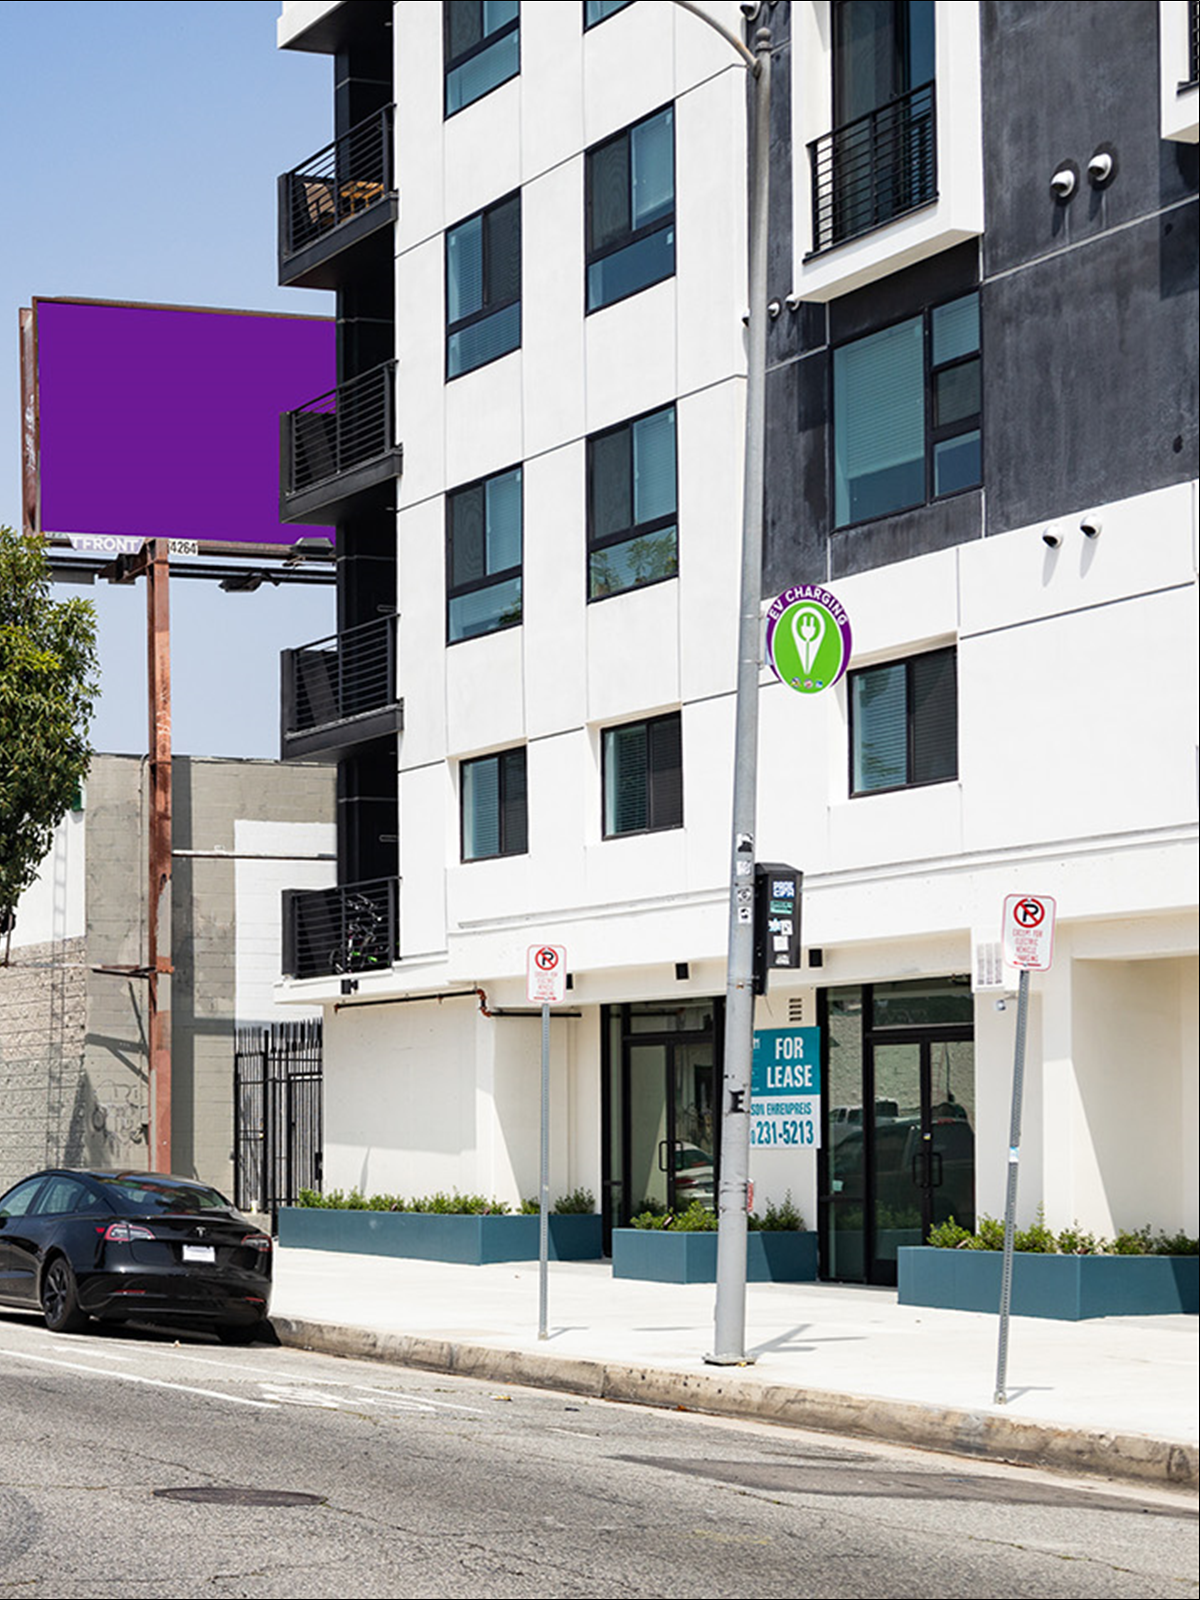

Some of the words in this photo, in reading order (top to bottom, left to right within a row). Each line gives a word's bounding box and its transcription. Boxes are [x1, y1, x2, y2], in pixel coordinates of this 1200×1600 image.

[170, 540, 197, 554] 4264
[769, 600, 784, 620] EV
[785, 586, 848, 626] CHARGING
[775, 1036, 804, 1060] FOR
[766, 1064, 813, 1088] LEASE
[750, 1103, 765, 1116] SON
[756, 1120, 814, 1144] 231-5213
